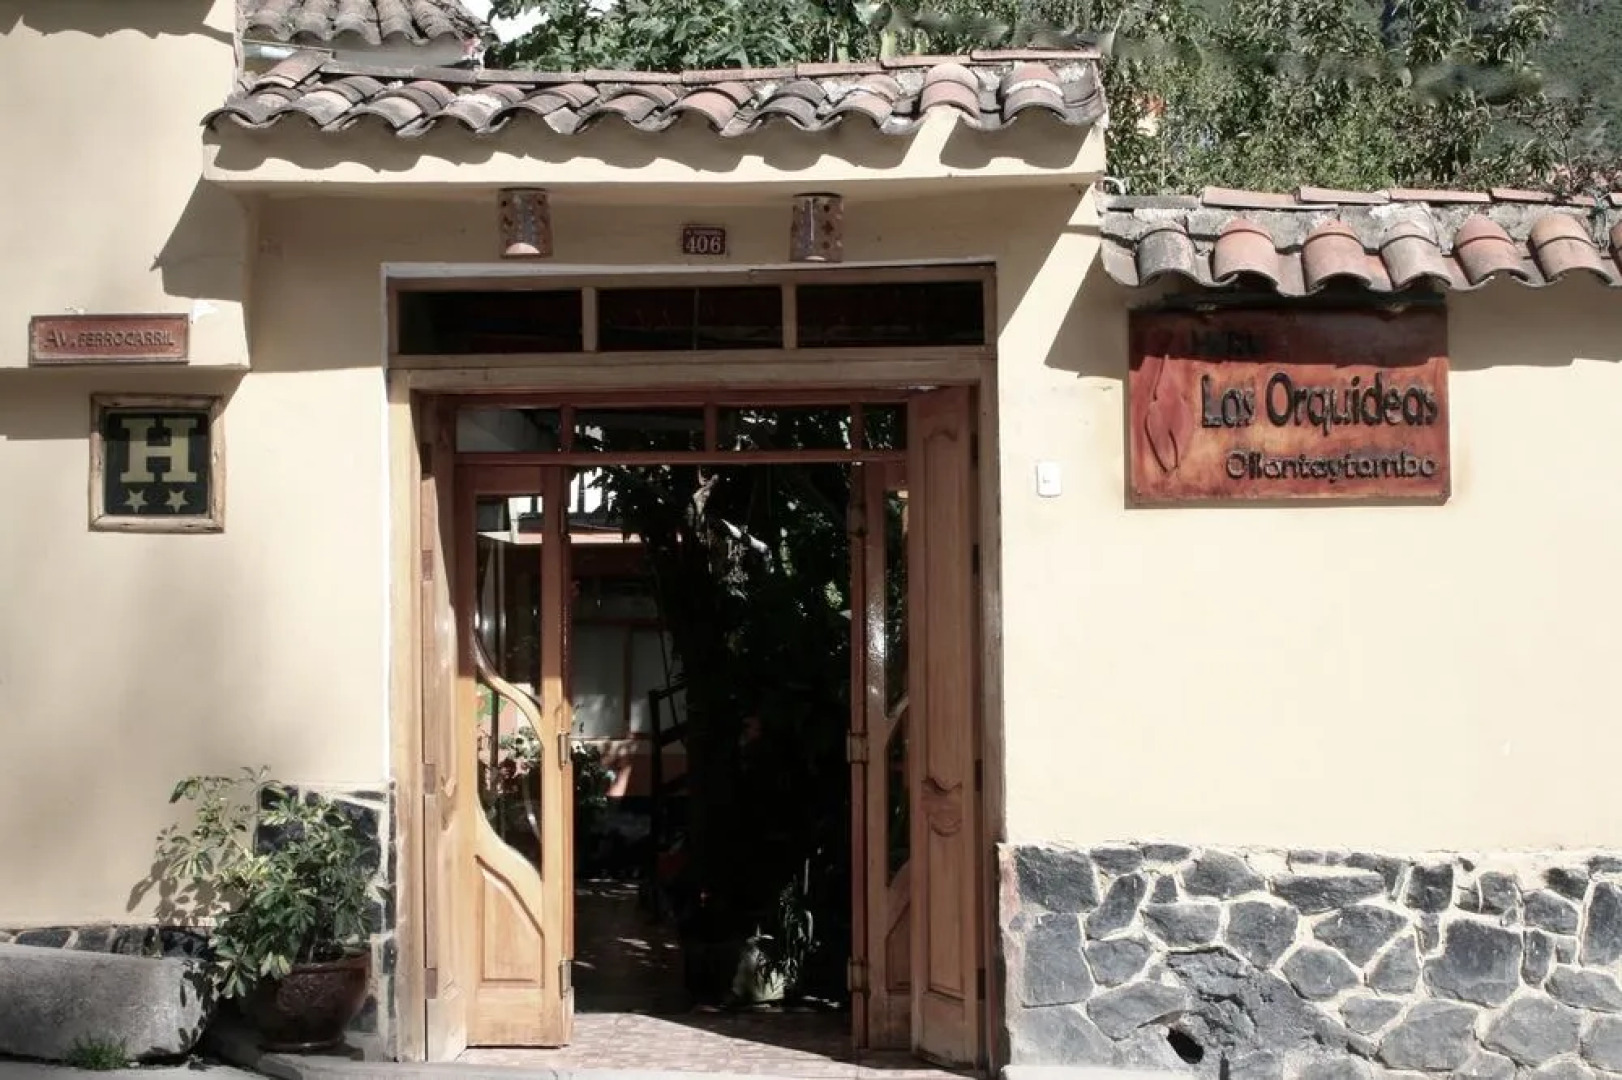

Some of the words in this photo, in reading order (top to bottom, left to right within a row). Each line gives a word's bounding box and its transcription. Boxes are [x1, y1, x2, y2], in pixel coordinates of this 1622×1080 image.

[685, 236, 721, 254] 406
[77, 330, 175, 348] FERROCARRIL
[1201, 375, 1254, 428] Las
[1265, 372, 1438, 437] Orquideas
[120, 418, 197, 483] H
[1225, 451, 1437, 484] Ollantaytambo
